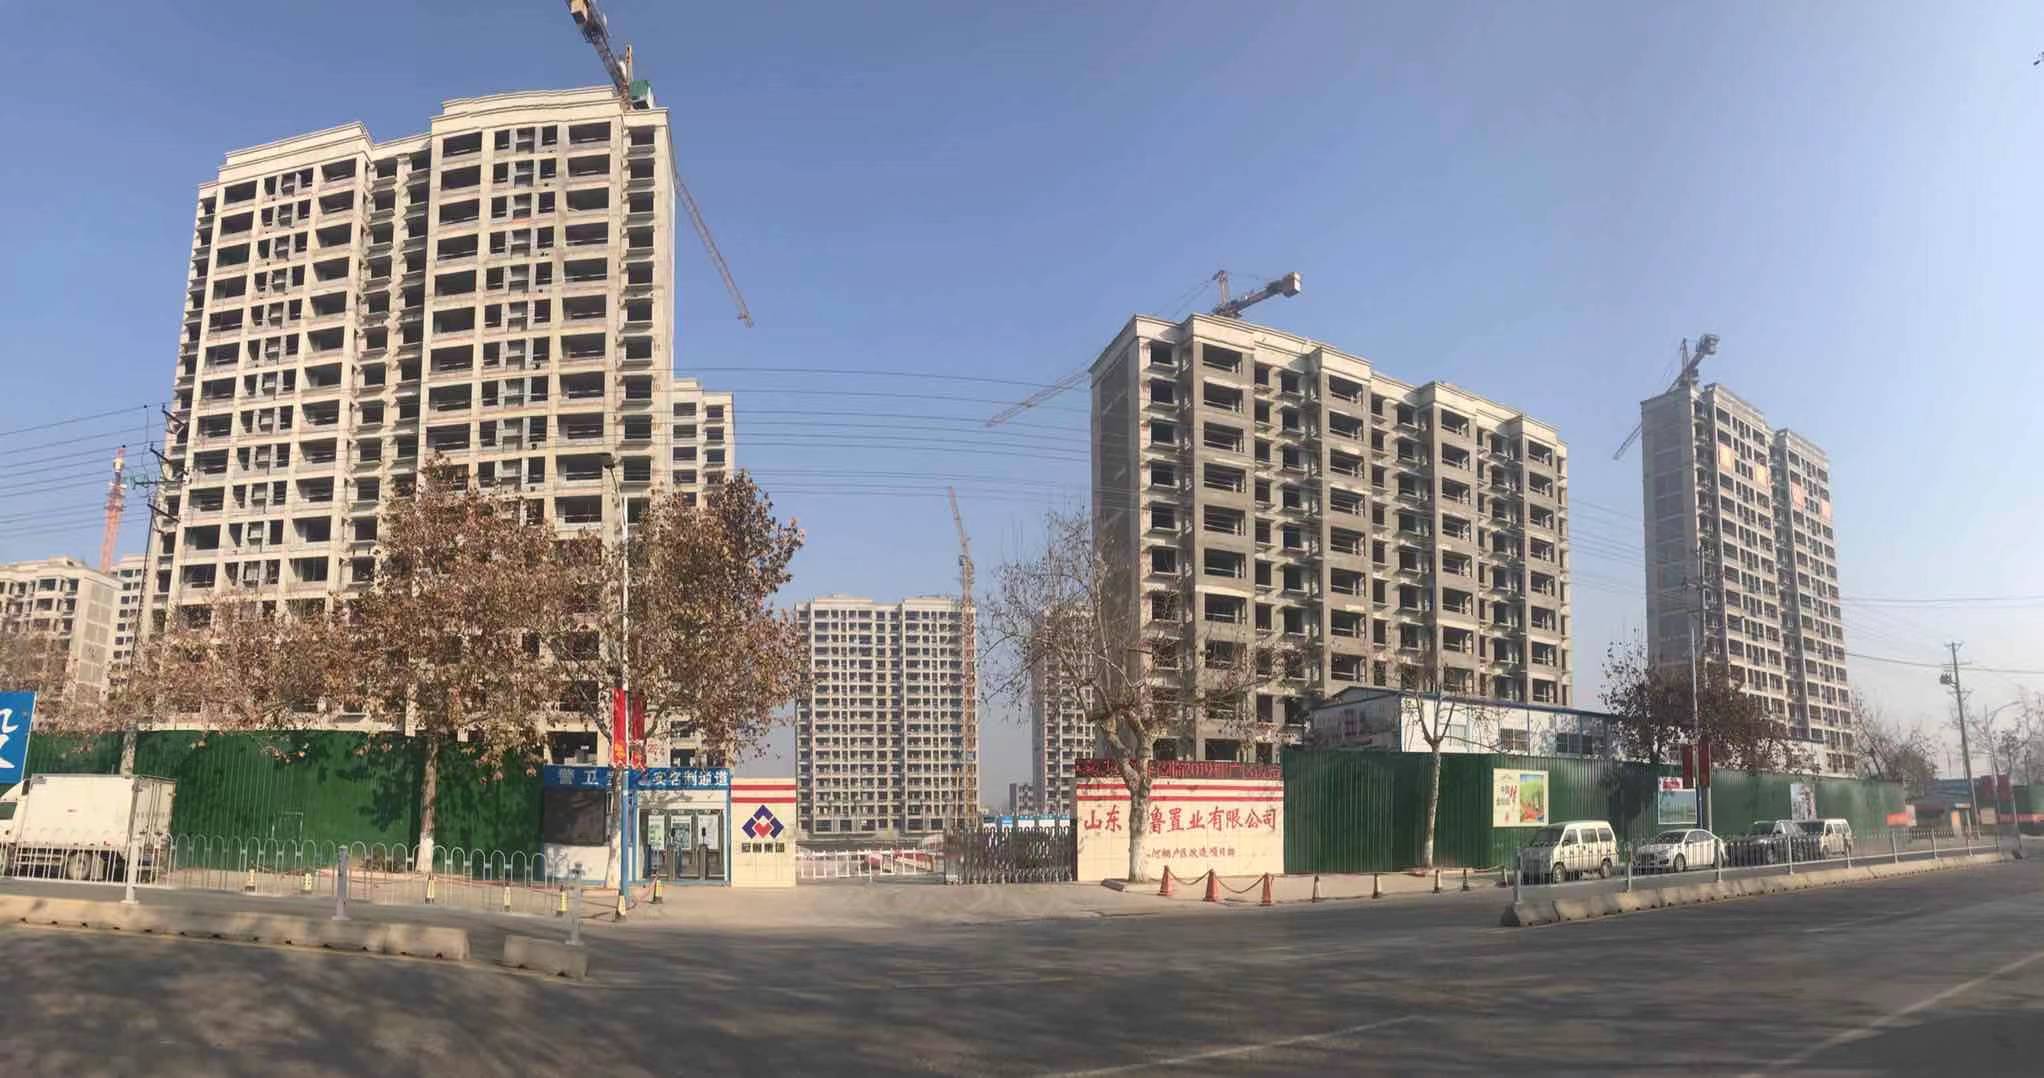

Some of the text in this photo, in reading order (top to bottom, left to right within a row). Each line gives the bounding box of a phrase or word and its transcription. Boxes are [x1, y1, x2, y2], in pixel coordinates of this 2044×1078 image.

[638, 769, 729, 787] 实名制通道
[1084, 805, 1276, 834] 山东鲁置业有限公司
[1146, 846, 1236, 859] 河棚户区改造项目部
